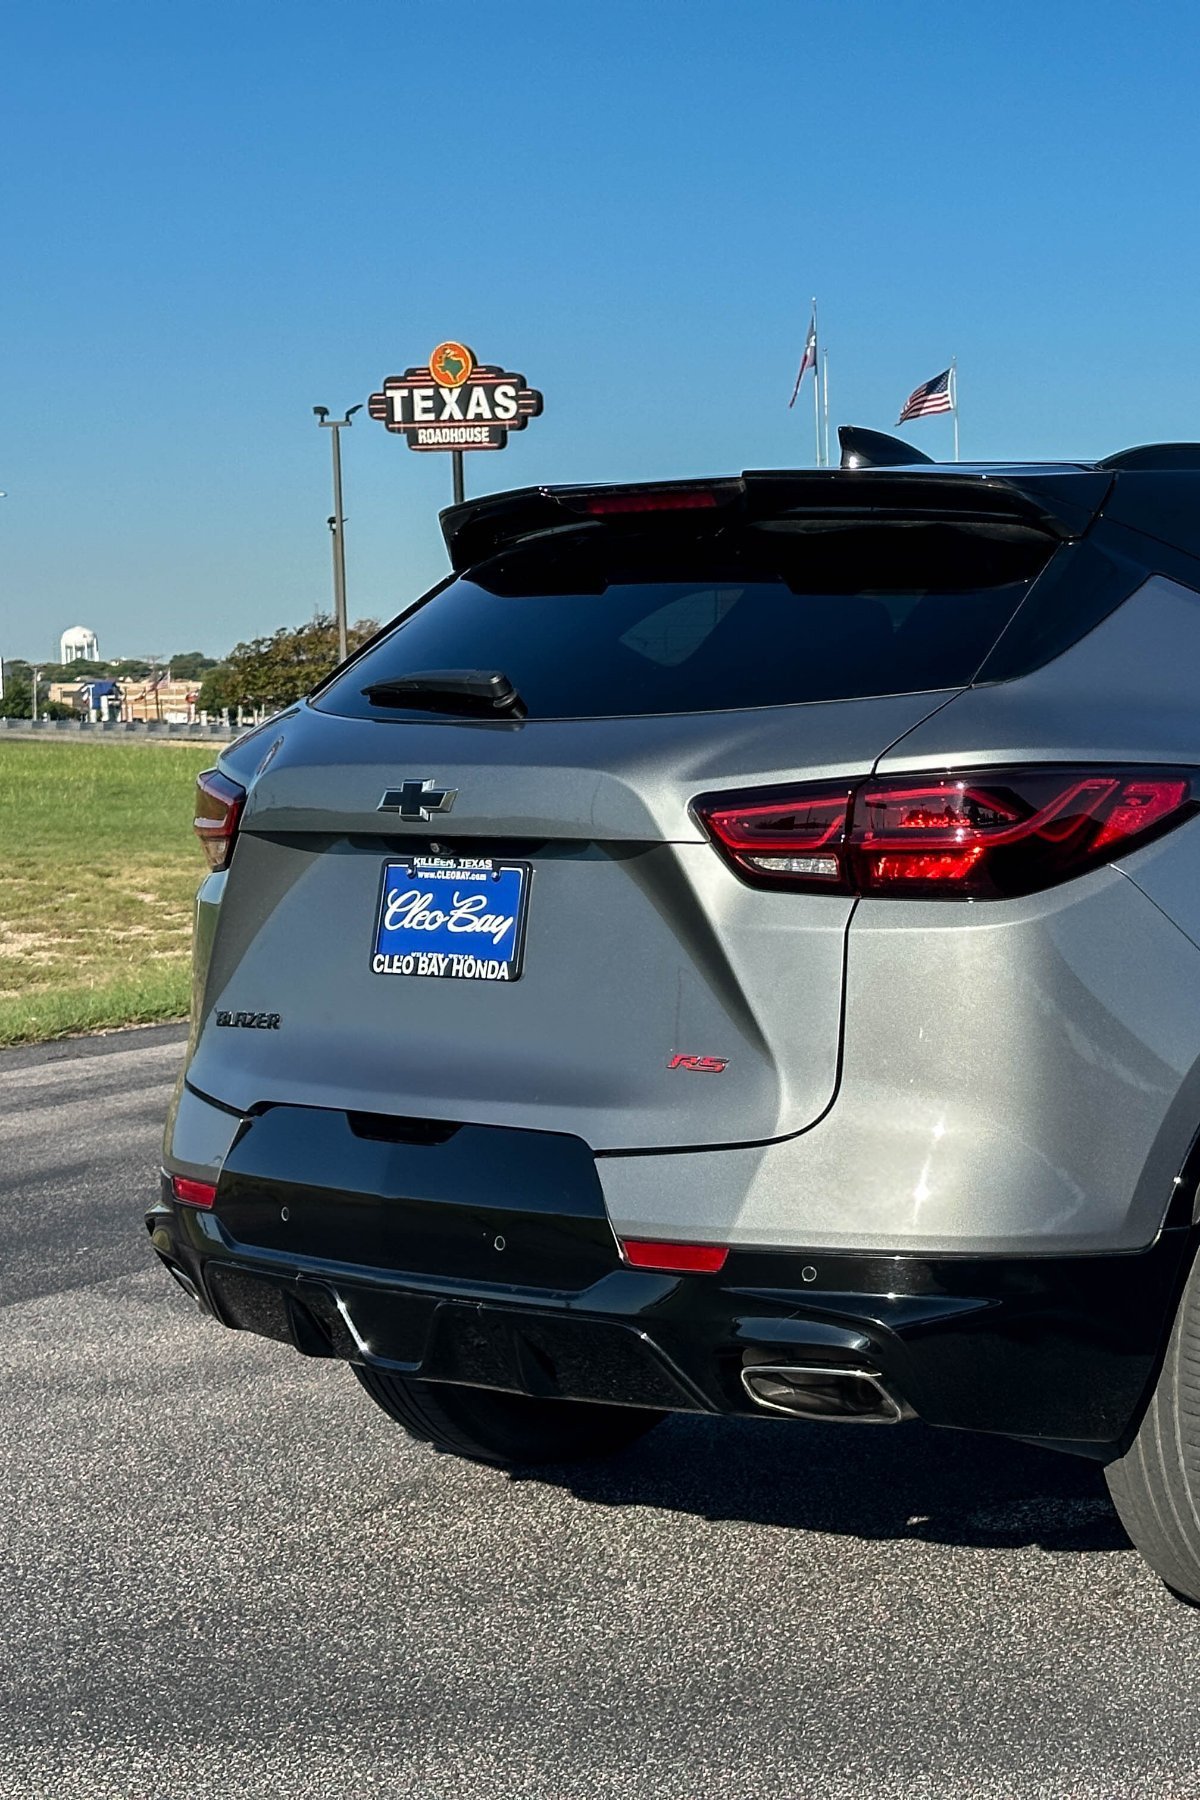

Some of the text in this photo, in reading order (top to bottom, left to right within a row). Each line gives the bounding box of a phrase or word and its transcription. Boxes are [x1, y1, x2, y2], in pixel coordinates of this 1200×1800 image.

[385, 385, 518, 422] TEXAS
[417, 426, 490, 444] ROADHOUSE
[458, 859, 493, 869] TEXAS
[385, 888, 514, 945] Cleo Bay
[372, 953, 509, 980] CLEO BAY HONDA
[216, 1011, 281, 1029] BLAZER
[666, 1053, 729, 1073] RS
